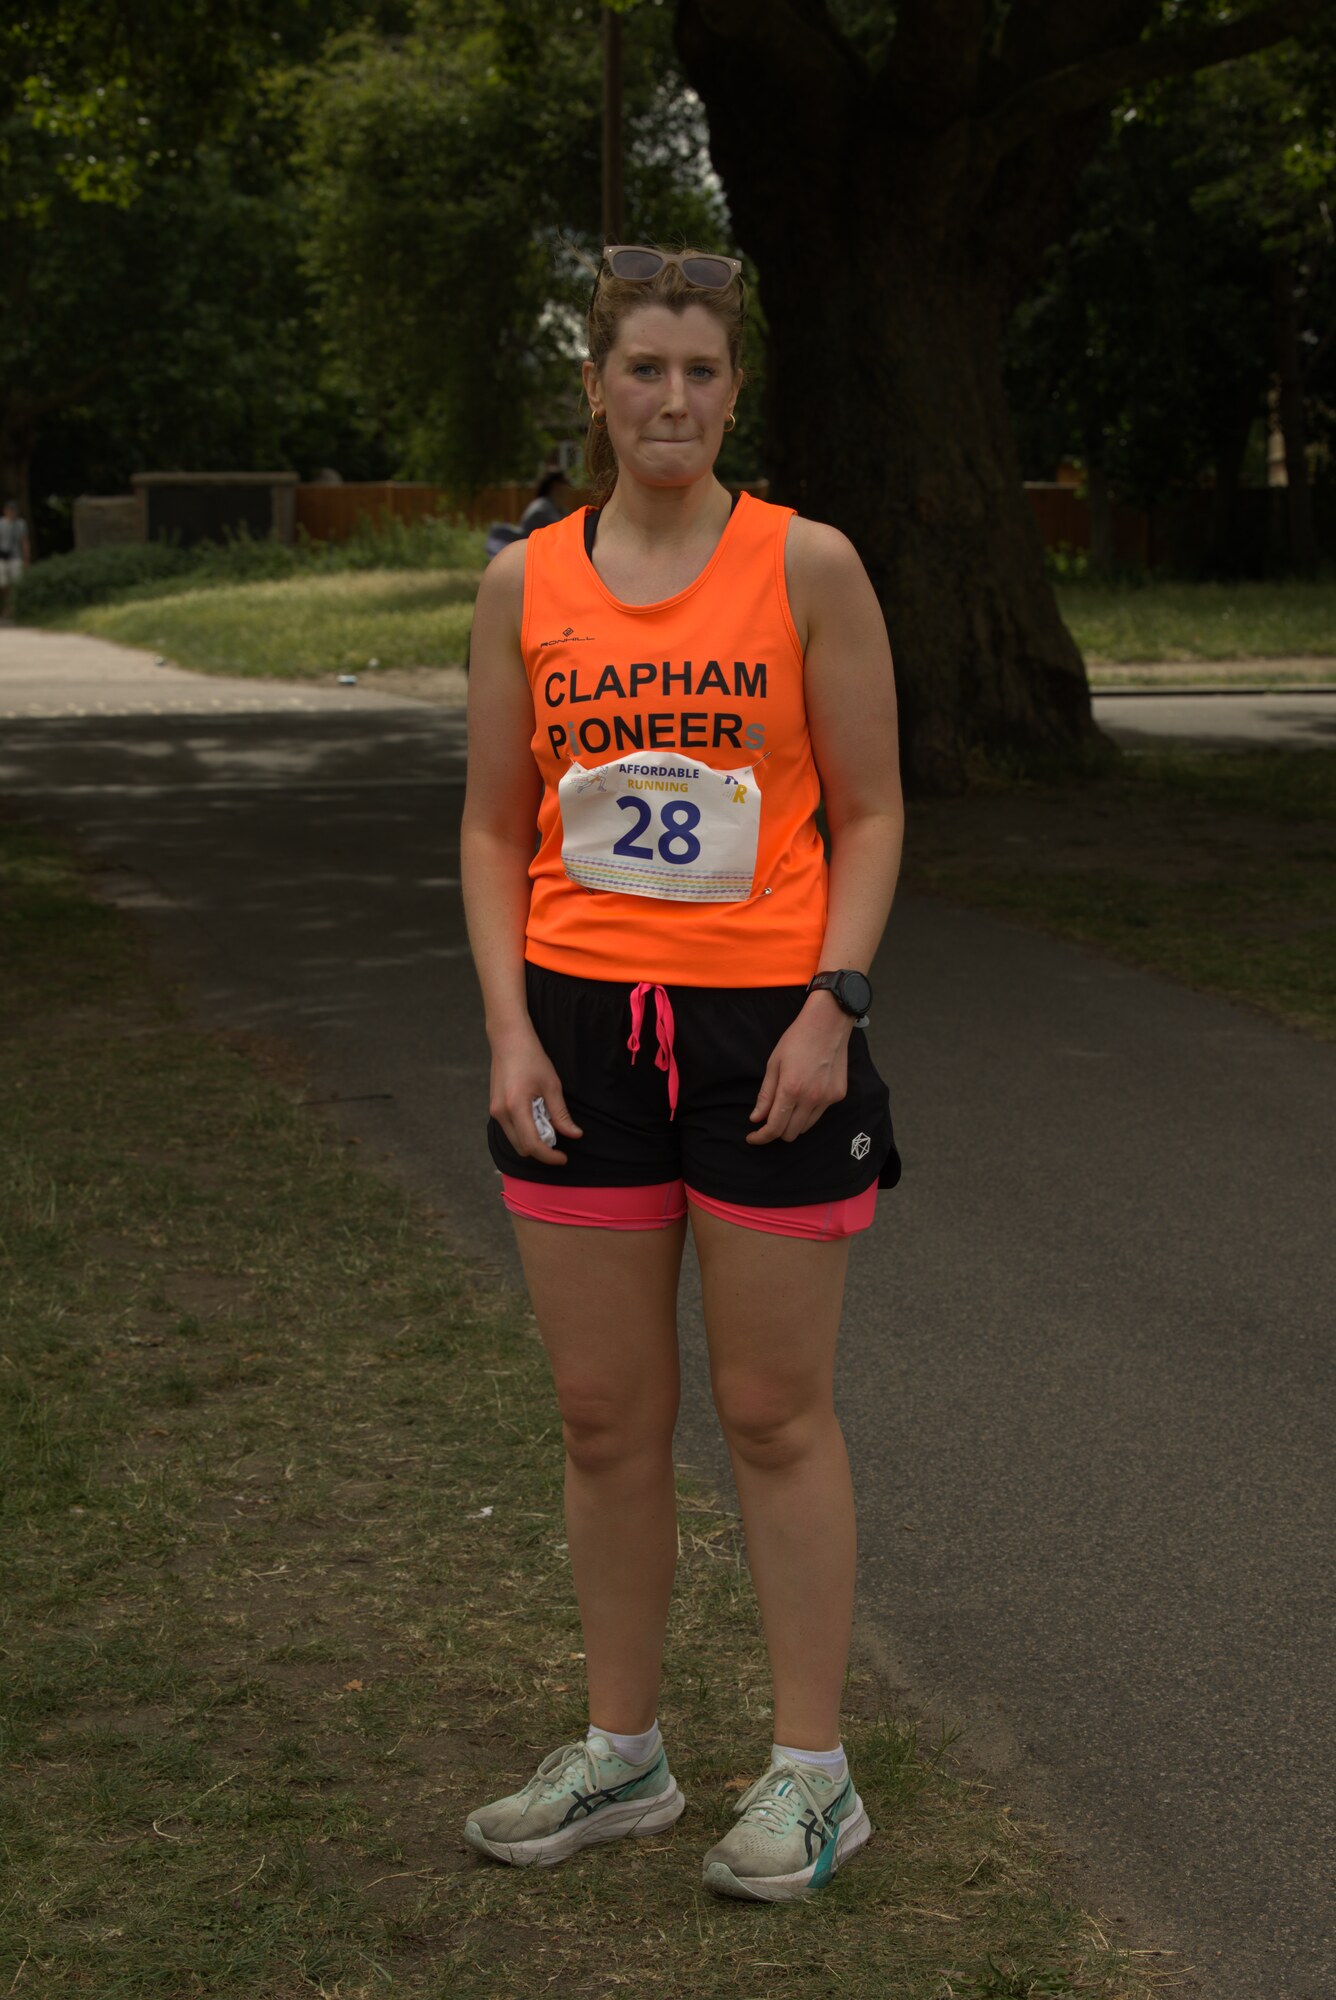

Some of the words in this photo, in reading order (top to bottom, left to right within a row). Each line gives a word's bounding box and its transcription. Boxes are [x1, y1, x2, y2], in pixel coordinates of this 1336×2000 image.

[544, 660, 767, 708] CLAPHAM
[618, 763, 700, 779] AFFORDABLE
[627, 778, 689, 793] RUNNING
[612, 795, 701, 865] 28
